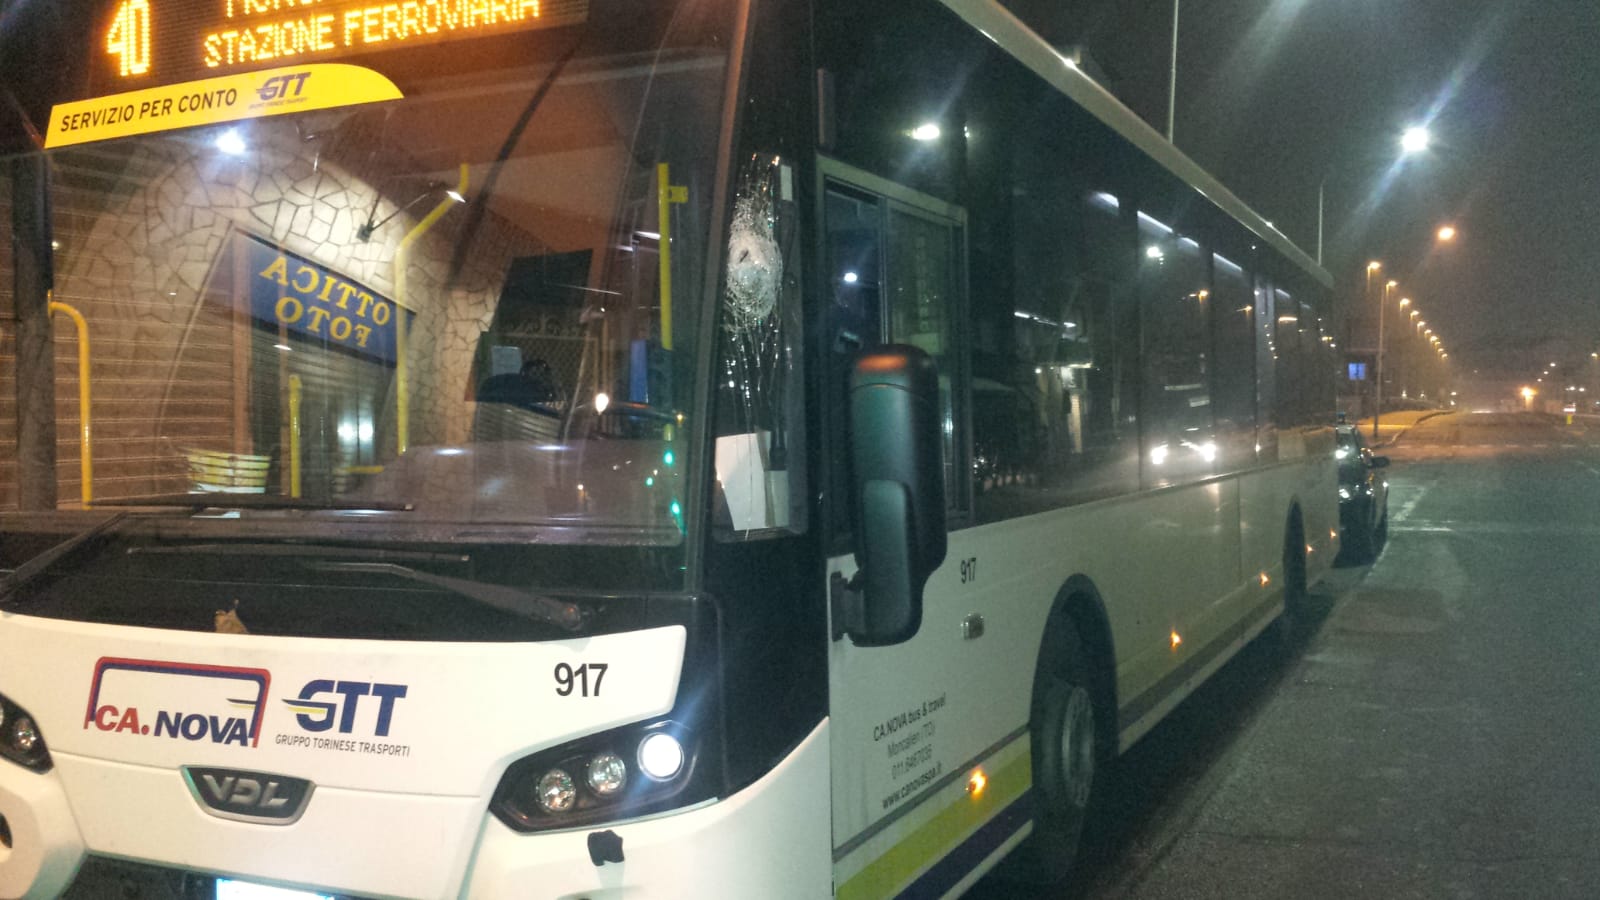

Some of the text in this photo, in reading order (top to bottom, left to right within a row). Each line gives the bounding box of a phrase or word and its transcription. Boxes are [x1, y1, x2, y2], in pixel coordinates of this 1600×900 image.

[107, 0, 149, 76] 40
[204, 0, 539, 67] STAZIONE FERROVIARIA
[257, 72, 311, 100] GTT
[61, 105, 134, 132] SERVIZIO
[139, 99, 171, 120] PER
[178, 88, 237, 112] CONTO
[960, 557, 976, 584] 917
[554, 662, 608, 697] 917
[282, 679, 408, 736] GTT
[908, 709, 921, 724] bus
[275, 734, 410, 757] GRUPPO TORINESE TRASPORTI
[203, 775, 288, 807] VDL
